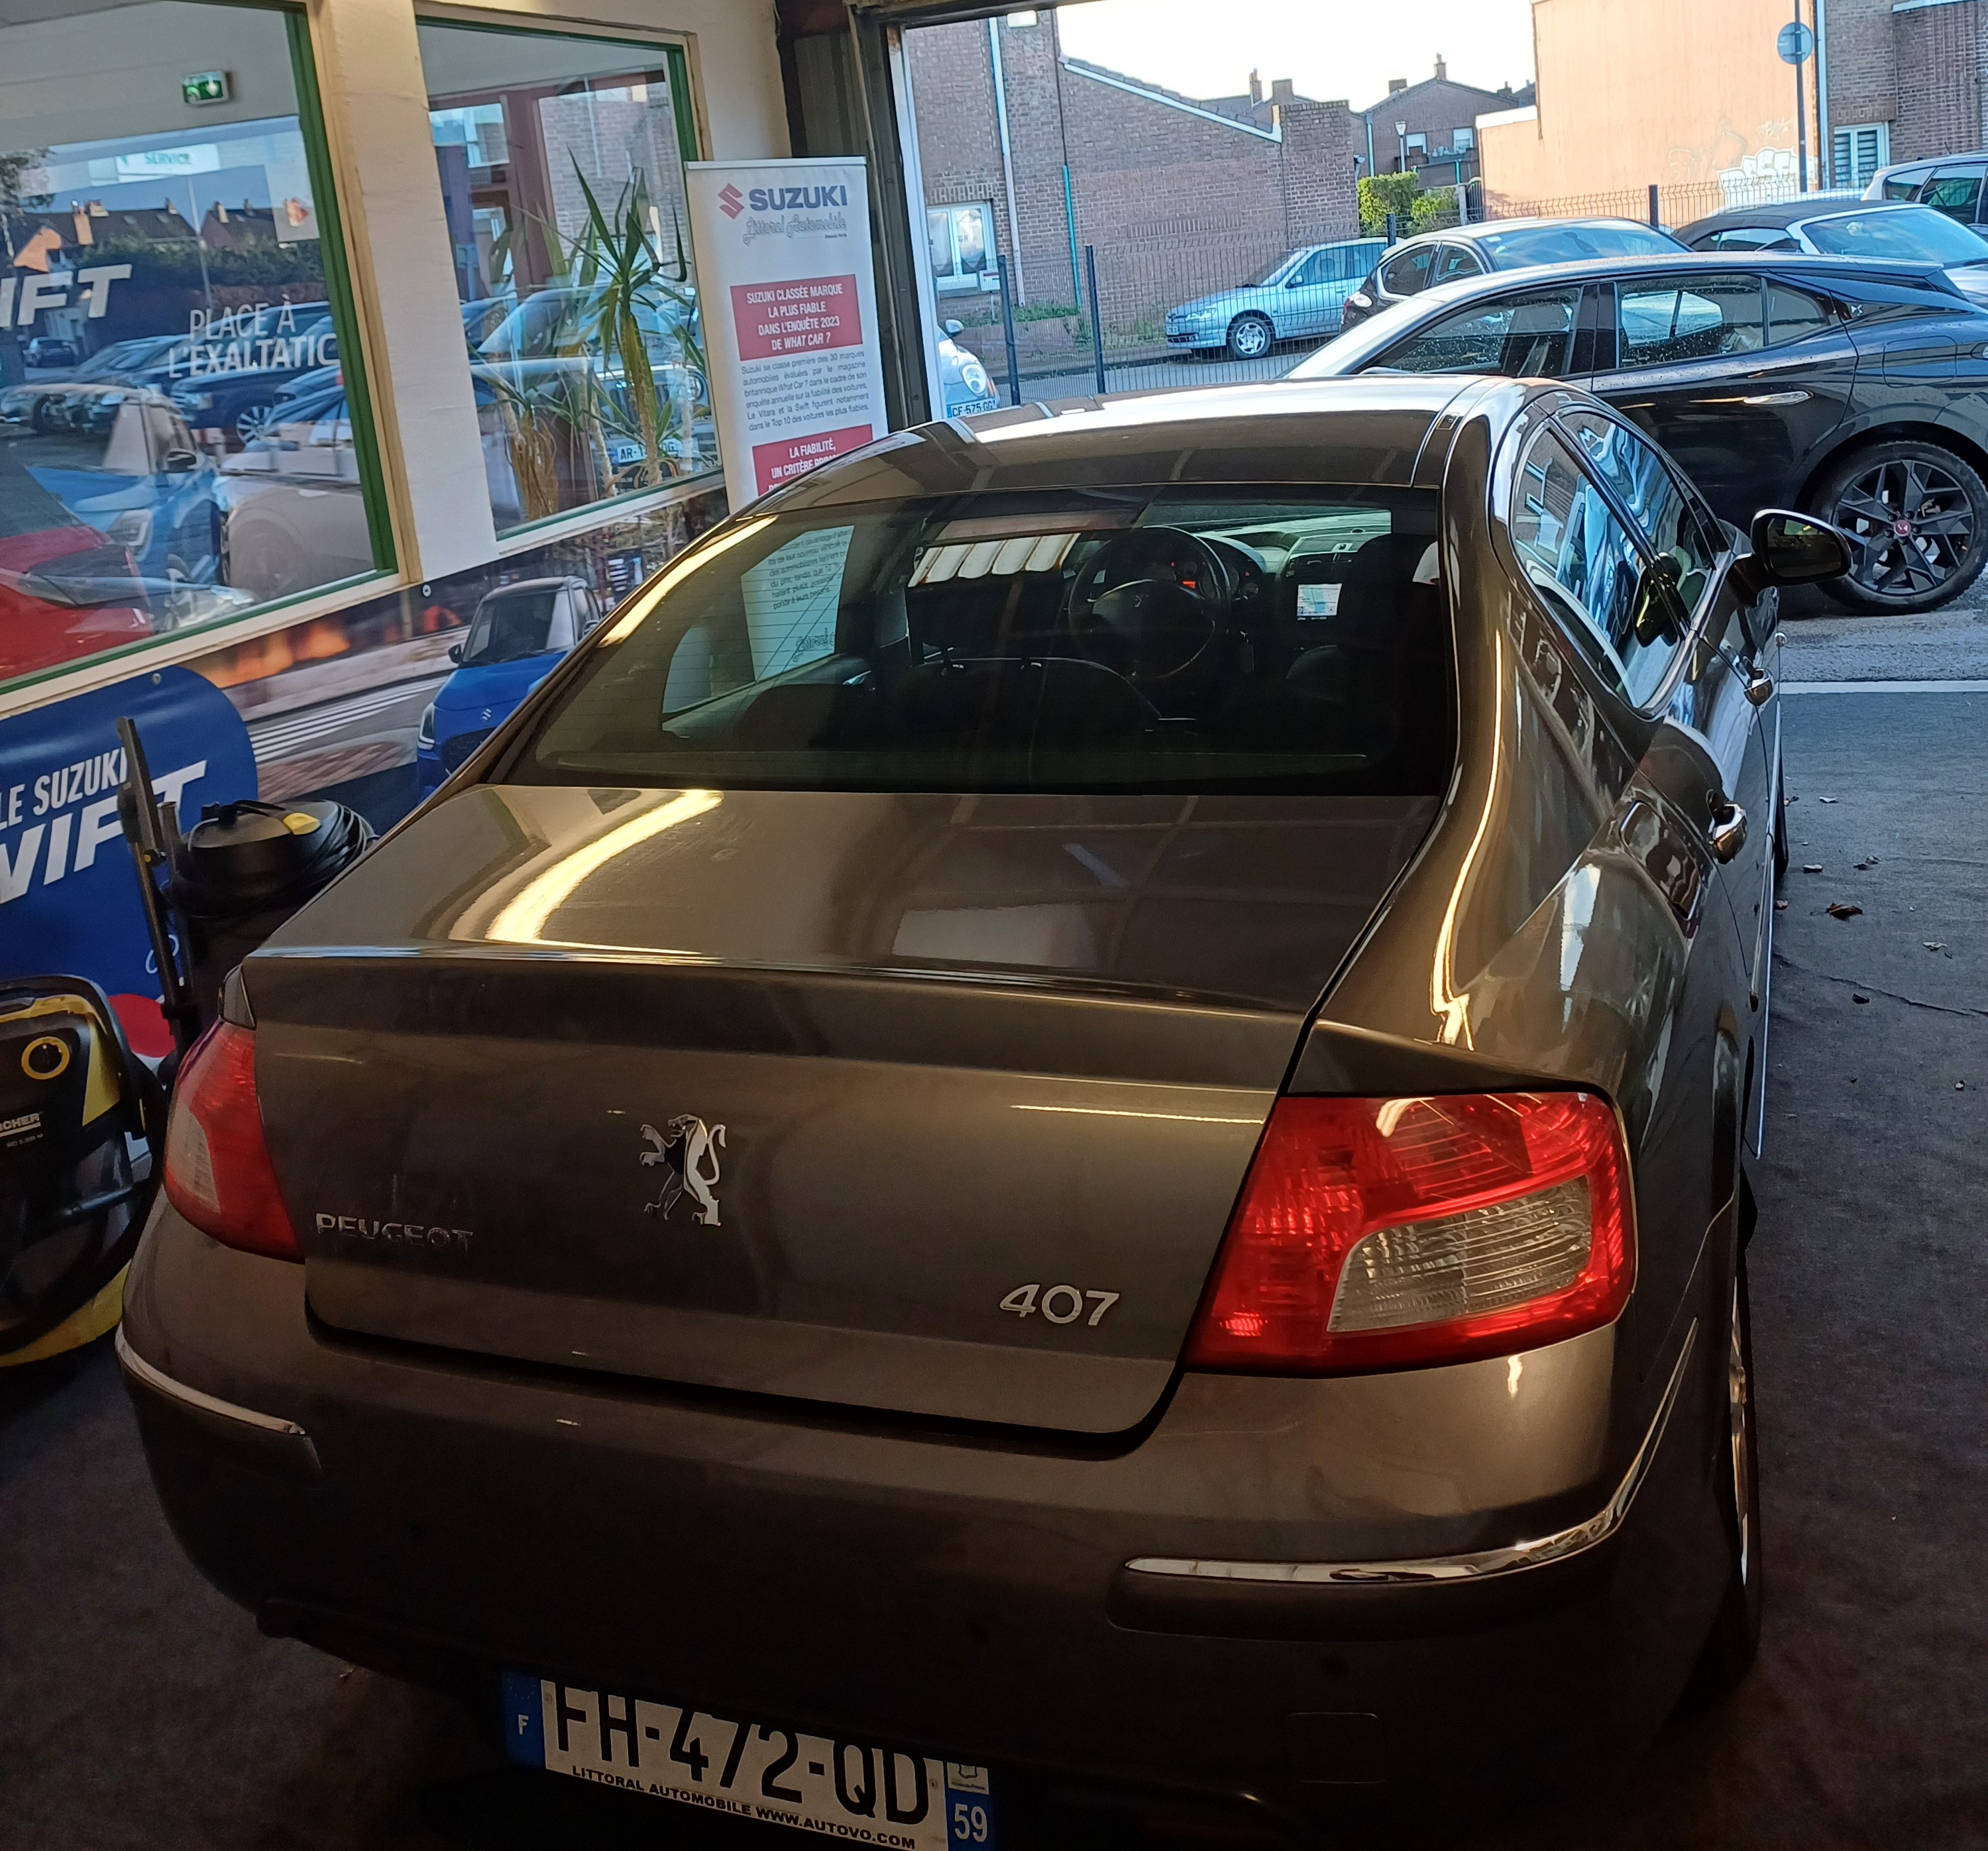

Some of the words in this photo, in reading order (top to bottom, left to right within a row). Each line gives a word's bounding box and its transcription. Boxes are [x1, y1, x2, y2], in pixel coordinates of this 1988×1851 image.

[749, 185, 848, 211] SUZUKI
[746, 290, 775, 304] SUZUKI
[776, 285, 808, 300] CLASSÉE
[810, 284, 843, 297] MARQUE
[190, 303, 270, 341] PLACE
[276, 293, 296, 333] À
[767, 307, 779, 318] LA
[780, 304, 799, 317] PLUS
[800, 301, 826, 315] FIABLE
[758, 323, 780, 336] DANS
[781, 317, 820, 333] L'ENQUÊTE
[821, 315, 840, 327] 2023
[771, 339, 783, 350] DE
[784, 335, 806, 349] WHAT
[808, 333, 824, 346] CAR
[742, 364, 761, 374] Suzuki
[772, 361, 790, 370] classe
[792, 357, 816, 368] première
[840, 350, 865, 360] marques
[743, 374, 779, 386] automobiles
[784, 369, 808, 380] évaluées
[838, 361, 865, 371] magazine
[744, 386, 777, 397] britannique
[746, 398, 770, 409] enquête
[771, 394, 794, 404] annuelle
[810, 386, 830, 397] fiabilité
[758, 409, 775, 417] Vitara
[795, 402, 809, 411] Swift
[812, 398, 833, 409] figurent
[836, 393, 869, 403] notamment
[749, 423, 763, 431] dans
[771, 419, 782, 427] Top
[803, 411, 824, 421] voitures
[835, 407, 847, 416] plus
[789, 447, 799, 458] LA
[800, 437, 836, 456] FIABILITÉ,
[771, 467, 782, 479] UN
[783, 459, 813, 476] CRITÈRE
[32, 747, 127, 816] SUZUKI
[315, 1212, 474, 1251] PEUGEOT
[999, 1284, 1120, 1326] 407
[518, 1714, 529, 1735] F
[554, 1681, 929, 1825] FH-472-QD
[954, 1803, 988, 1843] 59
[572, 1765, 645, 1792] LITTORAL
[649, 1783, 751, 1815] AUTOMOBILE
[755, 1806, 916, 1850] WWW.AUTOVO.COM
